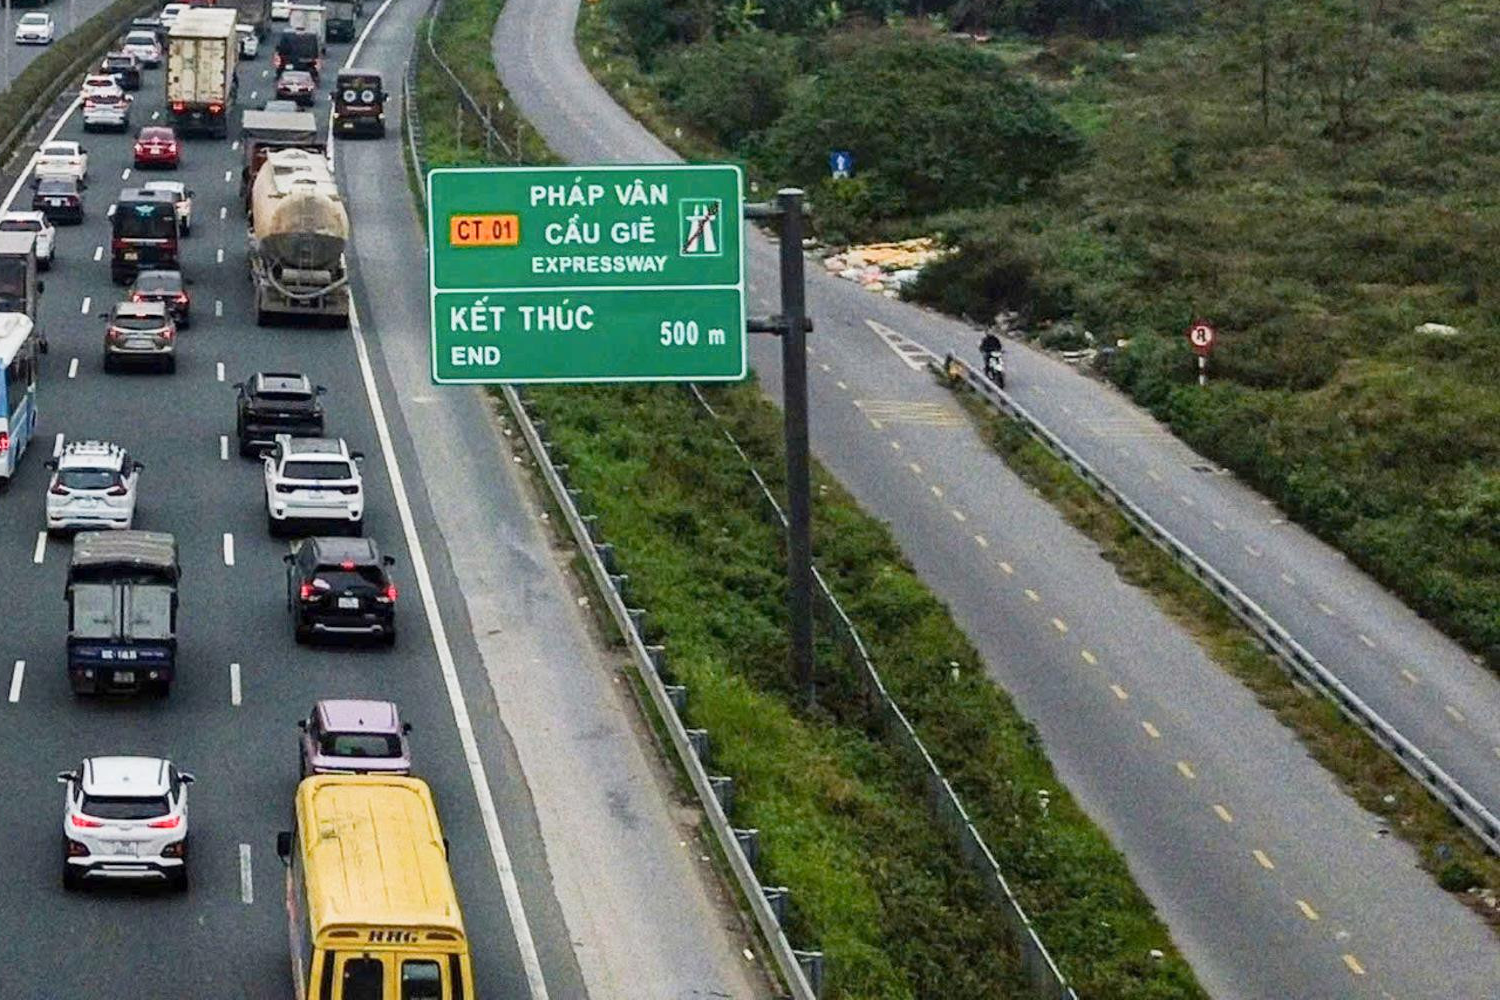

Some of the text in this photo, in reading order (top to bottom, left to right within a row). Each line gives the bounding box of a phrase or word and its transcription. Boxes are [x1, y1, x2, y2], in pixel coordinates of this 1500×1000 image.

[530, 175, 668, 207] PHÁP VÂN
[531, 255, 668, 273] EXPRESSWAY
[450, 296, 594, 332] KẾT THÚC
[660, 320, 725, 346] 500 m
[451, 346, 501, 366] END
